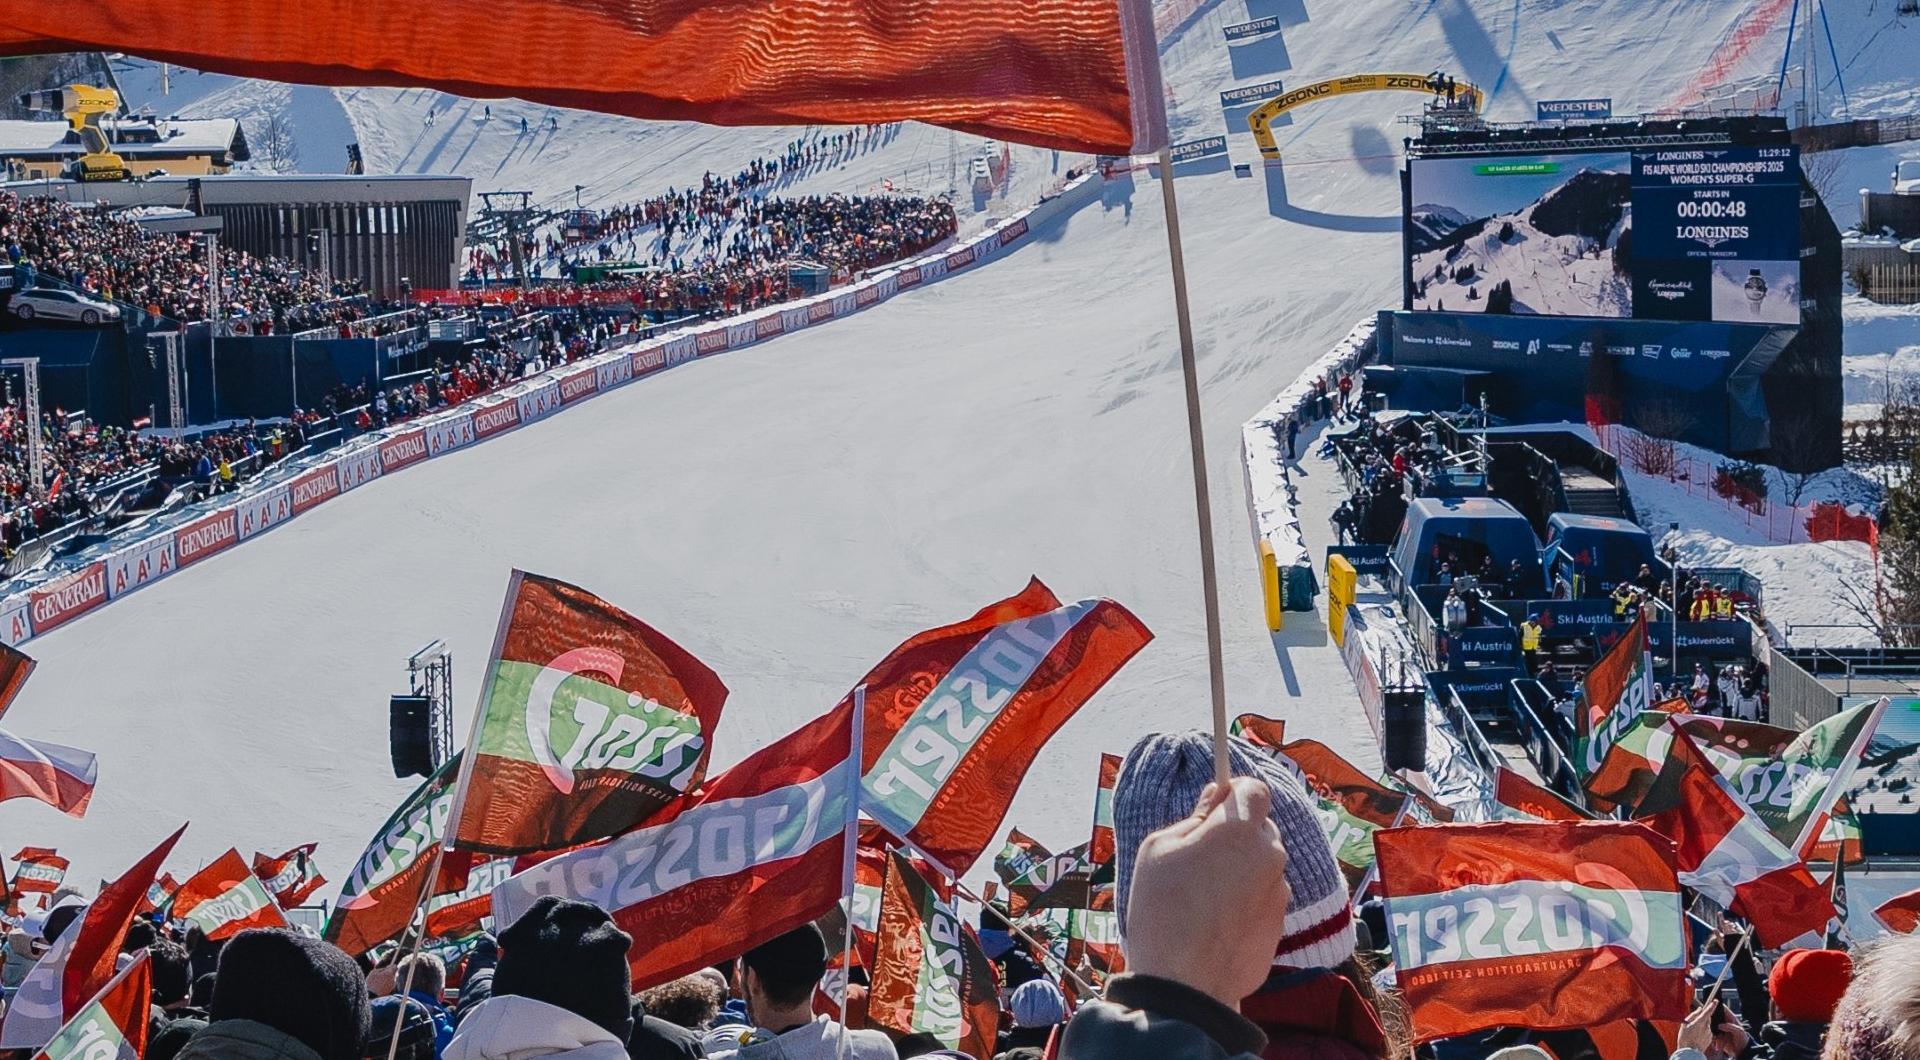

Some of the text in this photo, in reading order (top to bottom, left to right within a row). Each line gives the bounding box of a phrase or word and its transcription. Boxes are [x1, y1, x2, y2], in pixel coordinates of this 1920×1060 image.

[1225, 18, 1276, 35] VREDESTEIN
[1222, 84, 1280, 100] VREDESTEIN
[1277, 83, 1331, 110] ZGONC
[78, 98, 114, 107] ZGONC
[1540, 101, 1608, 112] VREDESTEIN
[1170, 138, 1223, 155] EDESTEIN
[1758, 149, 1790, 157] 11:29:12
[1656, 151, 1705, 161] LONGINES
[86, 171, 122, 180] ZGONC
[1643, 161, 1784, 175] FIS ALPINE WORLD SKI CHAMPIONSHIPS 2025
[1671, 174, 1754, 184] WOMEN'S SUPER-G
[1721, 190, 1730, 198] IN
[1677, 201, 1746, 217] 00:00:48
[1677, 226, 1749, 238] LONGINES
[1527, 339, 1540, 354] A1
[633, 352, 665, 372] GENERALI
[562, 373, 596, 398] GENERALI
[476, 404, 517, 434] GENERALI
[382, 435, 425, 467] GENERALI
[293, 470, 337, 504] GENERALI
[243, 494, 289, 537] A1 A1 A1
[179, 514, 235, 558] GENERALI
[115, 542, 172, 595] A1 A1 A1
[1348, 557, 1386, 566] Ski Austria
[1281, 566, 1289, 607] Ski Austria
[33, 570, 105, 624] GENERALI
[12, 608, 26, 643] A1
[1558, 614, 1613, 624] Ski Austria
[1461, 641, 1512, 651] ki Austria
[1677, 635, 1734, 647] #skiverrückt
[1449, 682, 1503, 692] skiverrückt
